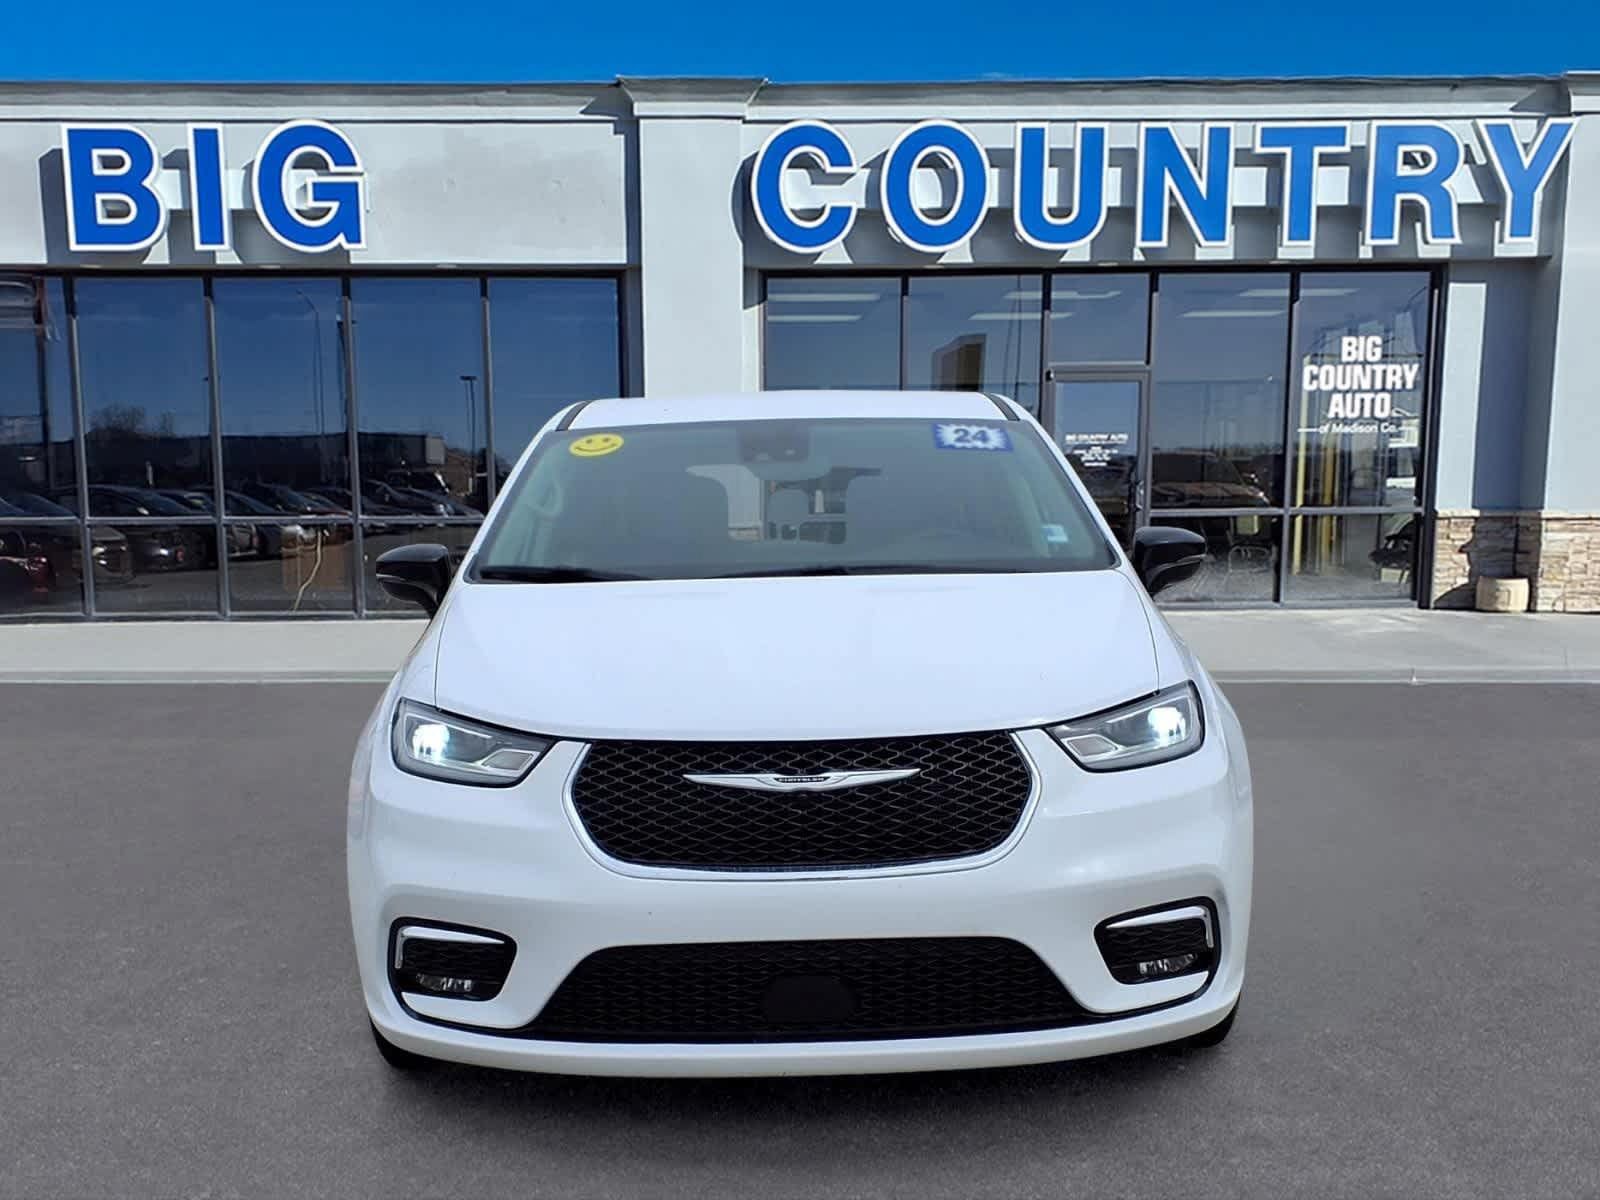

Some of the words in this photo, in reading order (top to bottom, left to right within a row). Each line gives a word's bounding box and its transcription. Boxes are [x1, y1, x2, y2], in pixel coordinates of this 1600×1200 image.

[61, 120, 367, 252] BIG
[751, 119, 1577, 253] COUNTRY
[1341, 336, 1382, 362] BIG
[1303, 364, 1419, 390] COUNTRY
[1328, 393, 1391, 418] AUTO
[954, 428, 988, 443] 24
[1319, 423, 1331, 433] of
[1331, 423, 1378, 432] Madison
